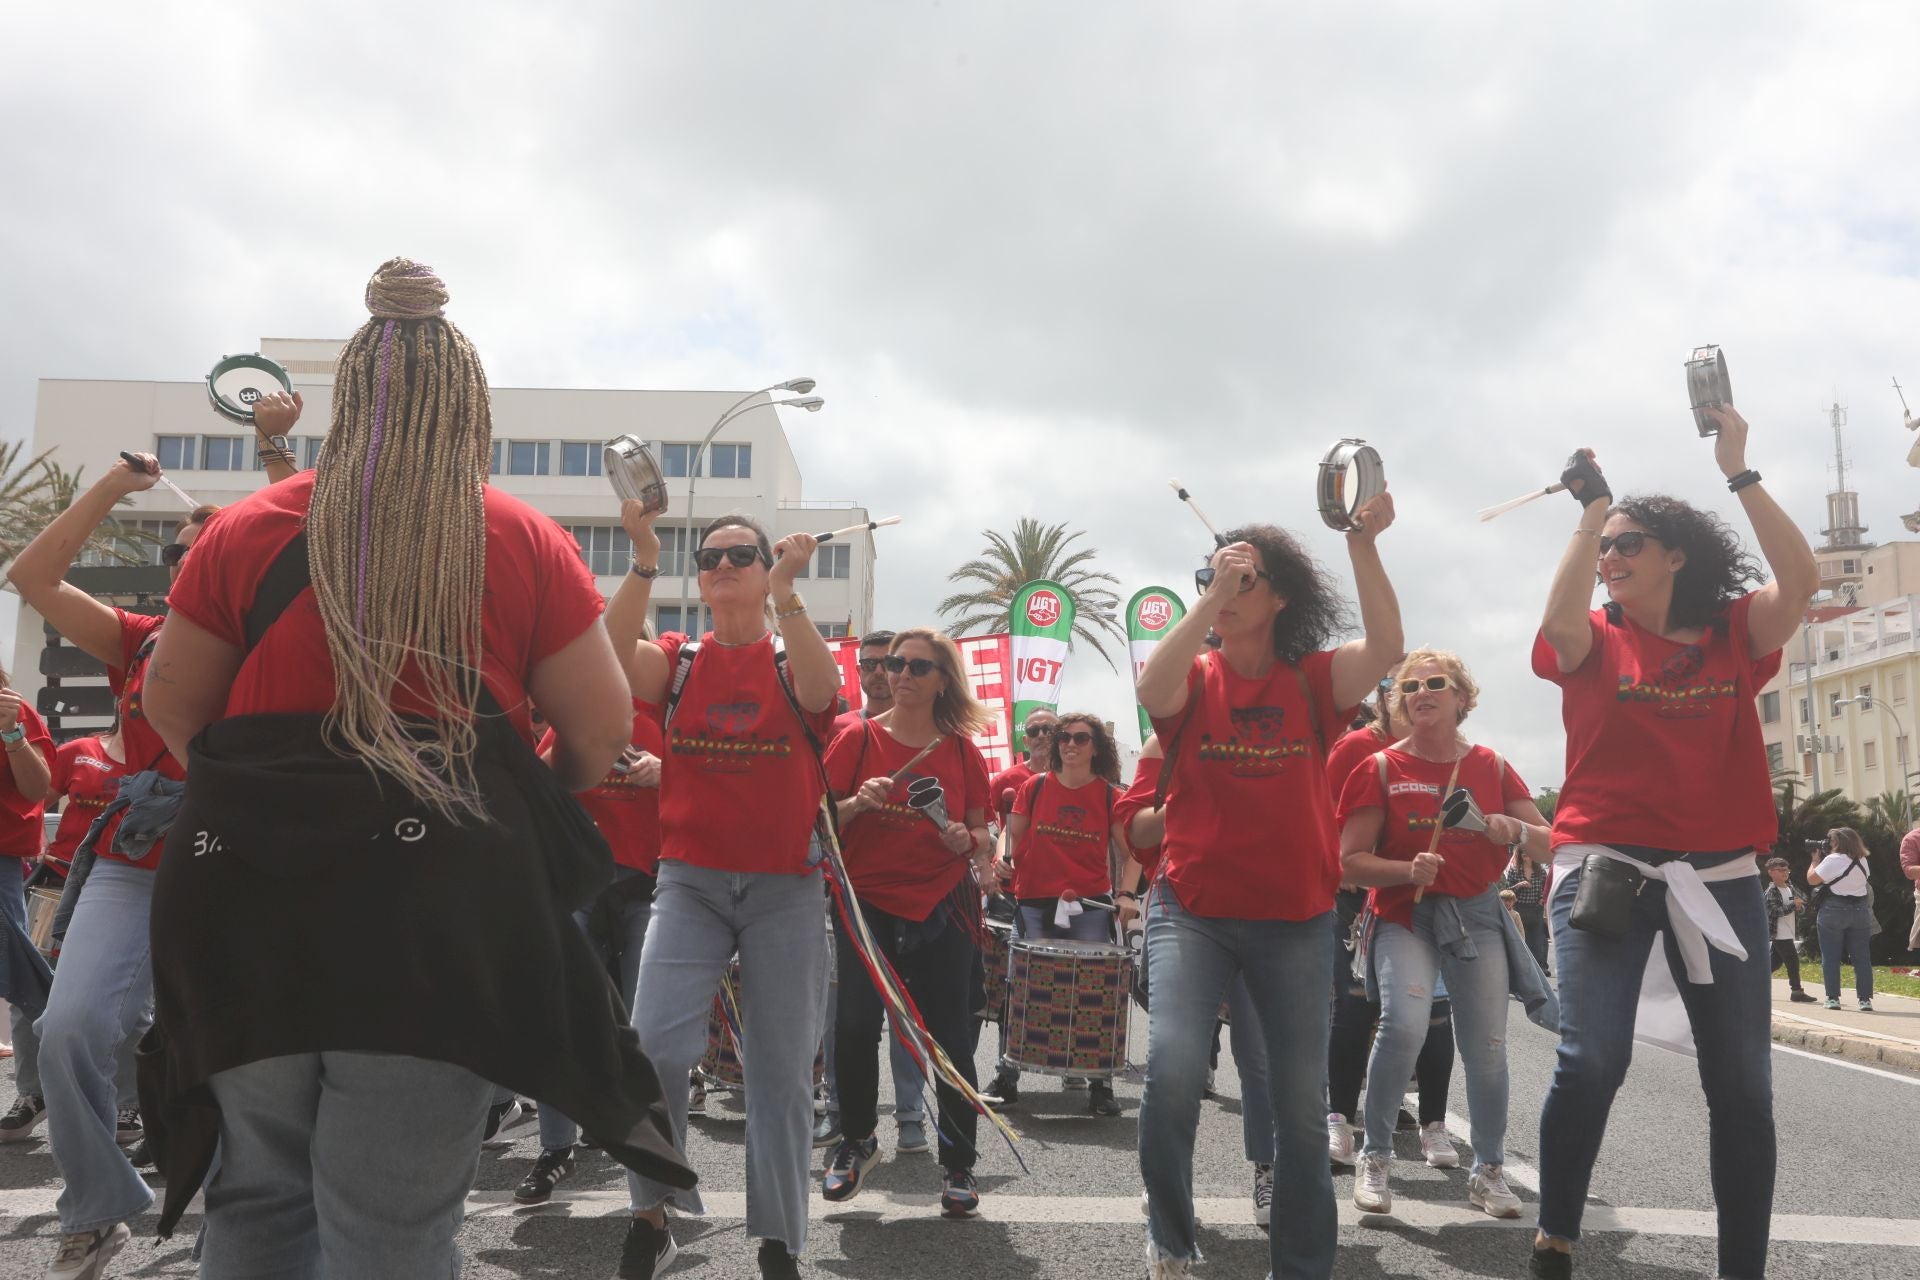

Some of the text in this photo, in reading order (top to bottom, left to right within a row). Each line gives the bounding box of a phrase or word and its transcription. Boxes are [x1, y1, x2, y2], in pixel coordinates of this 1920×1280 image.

[1030, 596, 1057, 614] UGT
[1142, 601, 1168, 616] UGT
[1017, 657, 1063, 685] UGT
